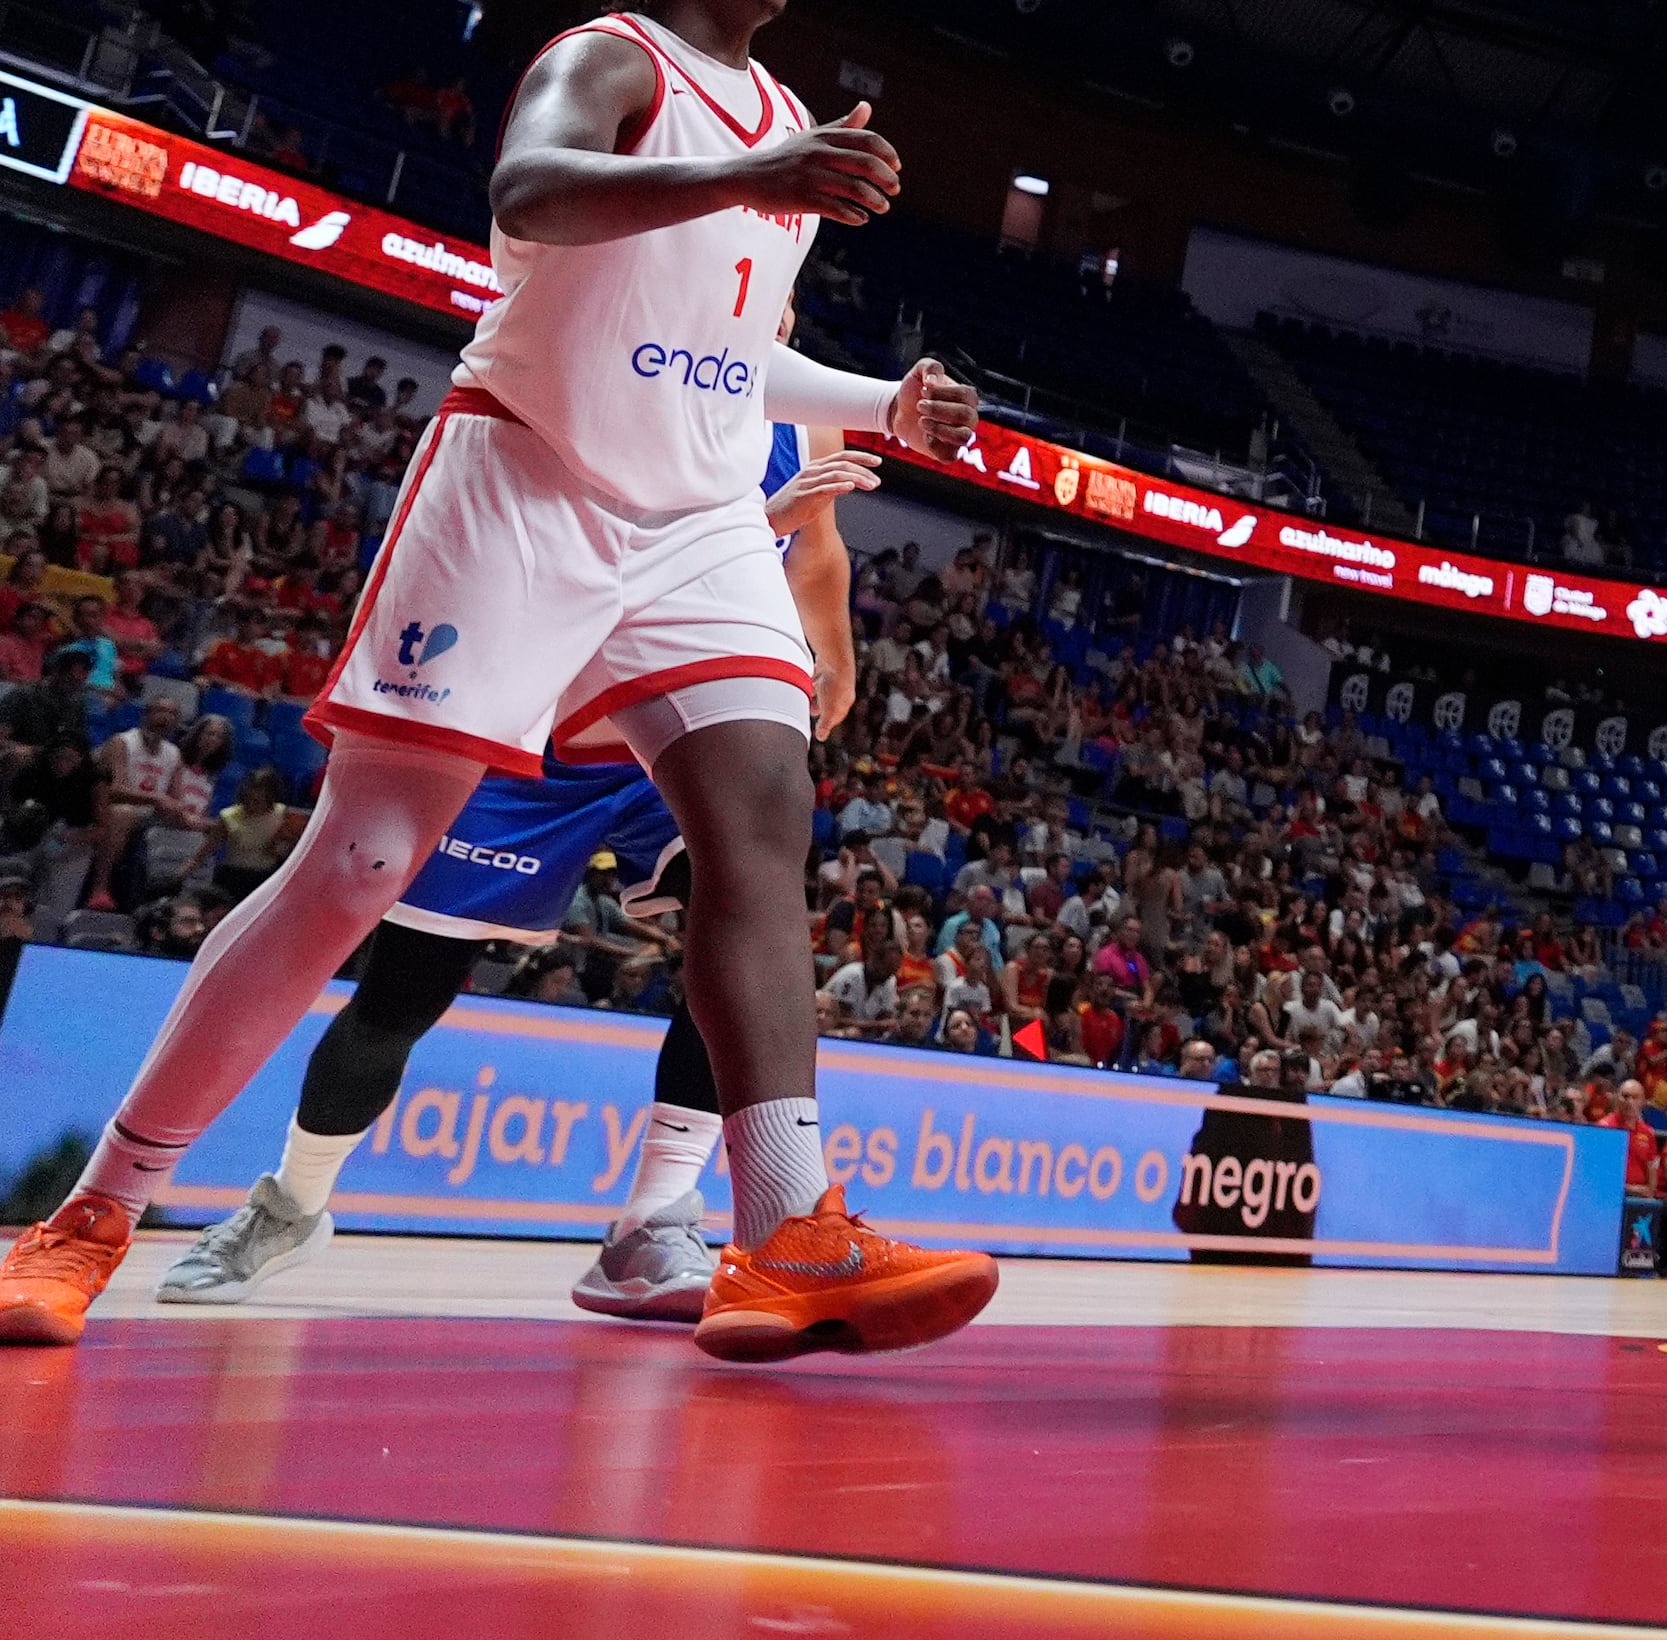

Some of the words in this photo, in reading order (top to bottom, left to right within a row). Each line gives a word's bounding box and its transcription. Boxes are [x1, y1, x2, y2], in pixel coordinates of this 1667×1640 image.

[179, 161, 300, 228] IBERIA
[733, 257, 752, 318] 1
[1143, 489, 1224, 533] IBERIA
[824, 1122, 898, 1190] es
[911, 1107, 1122, 1206] blanco
[1134, 1153, 1166, 1205] o
[1180, 1152, 1321, 1230] negro
